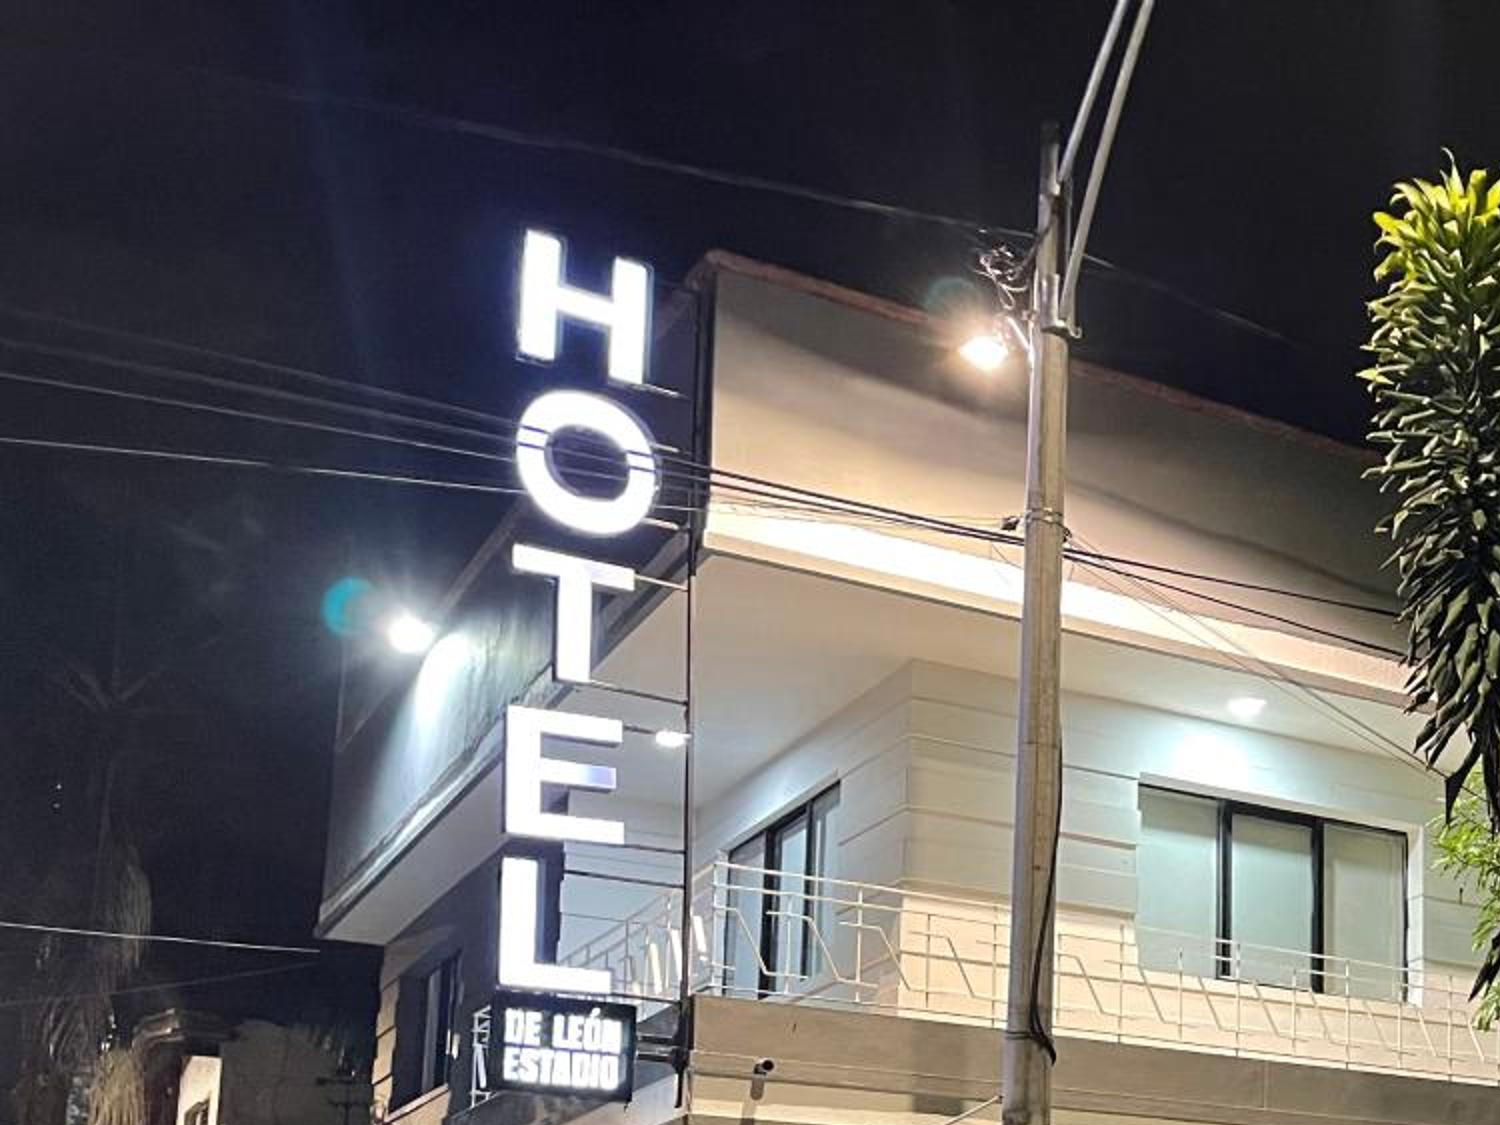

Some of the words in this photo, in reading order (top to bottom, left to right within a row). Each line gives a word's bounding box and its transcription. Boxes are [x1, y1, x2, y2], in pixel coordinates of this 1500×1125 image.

[495, 226, 660, 994] HOTEL
[504, 1006, 543, 1047] DE
[503, 1045, 620, 1091] ESTADIO
